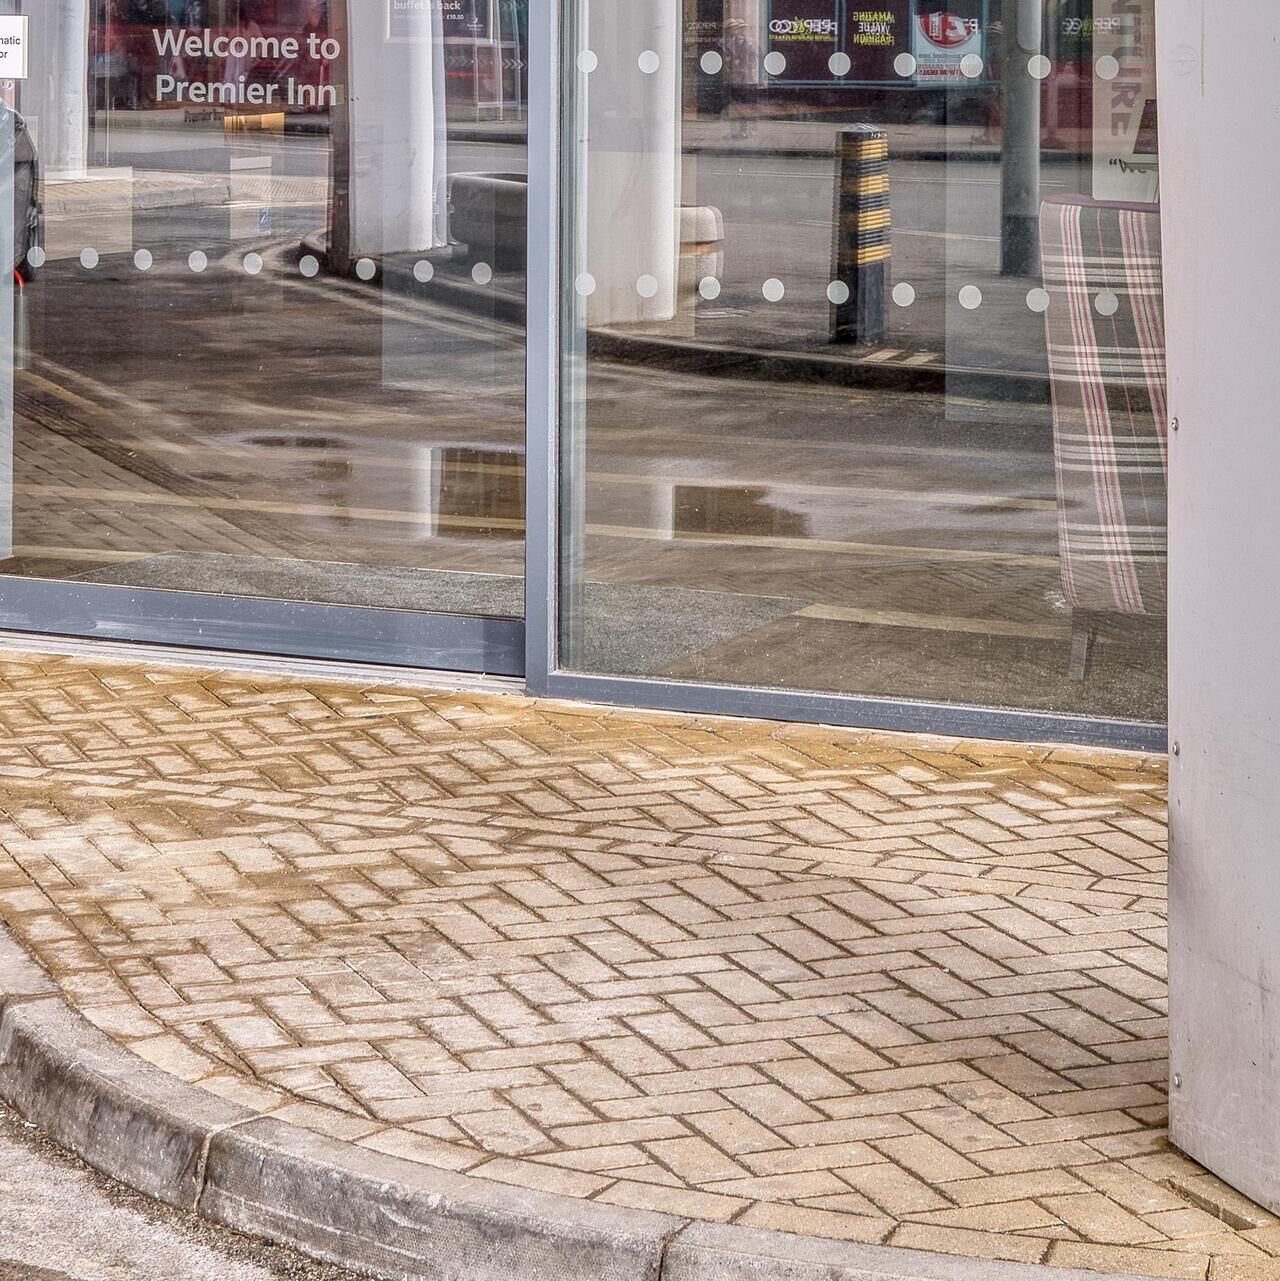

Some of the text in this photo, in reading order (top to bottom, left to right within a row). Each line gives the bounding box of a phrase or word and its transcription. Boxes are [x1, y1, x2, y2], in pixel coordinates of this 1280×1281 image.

[436, 0, 461, 10] back
[152, 27, 341, 60] Welcome to
[155, 74, 337, 106] Premier Inn
